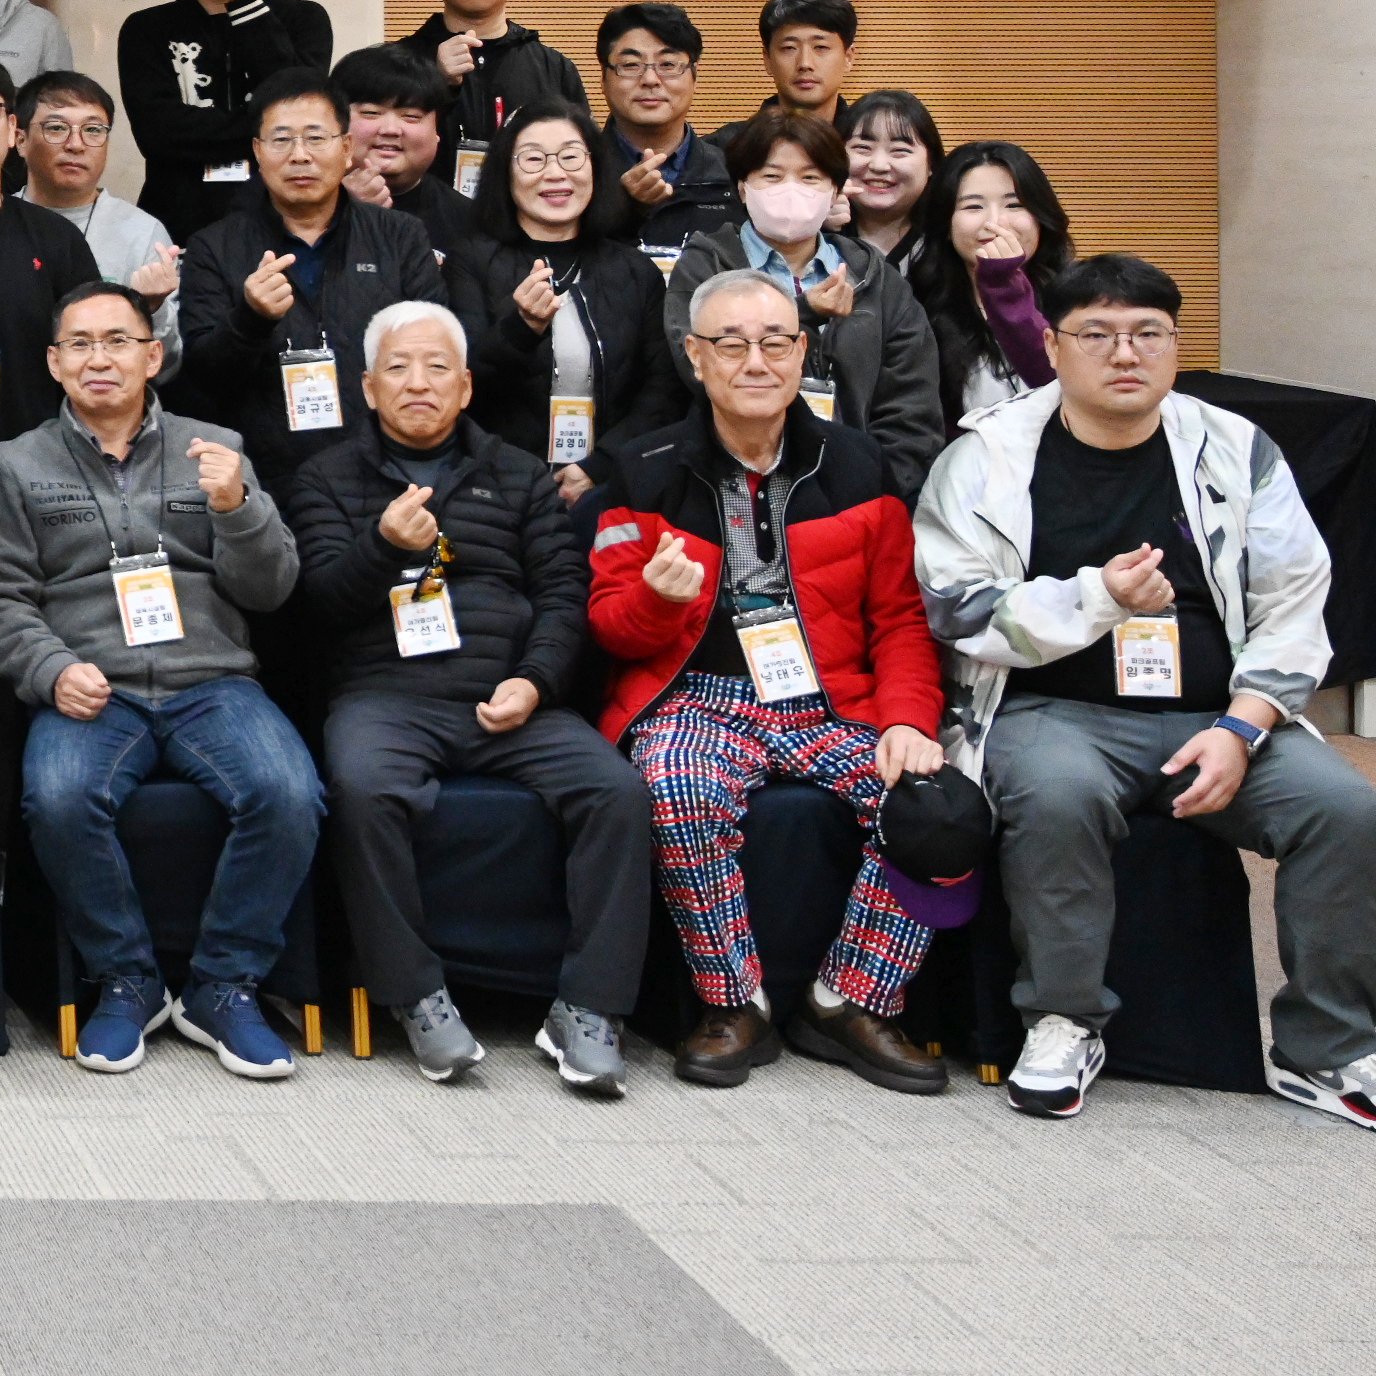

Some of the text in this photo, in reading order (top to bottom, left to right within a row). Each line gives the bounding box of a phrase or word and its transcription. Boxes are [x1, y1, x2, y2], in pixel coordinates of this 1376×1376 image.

[357, 263, 377, 273] K2
[555, 438, 586, 448] 김영미
[40, 511, 96, 526] TORINO
